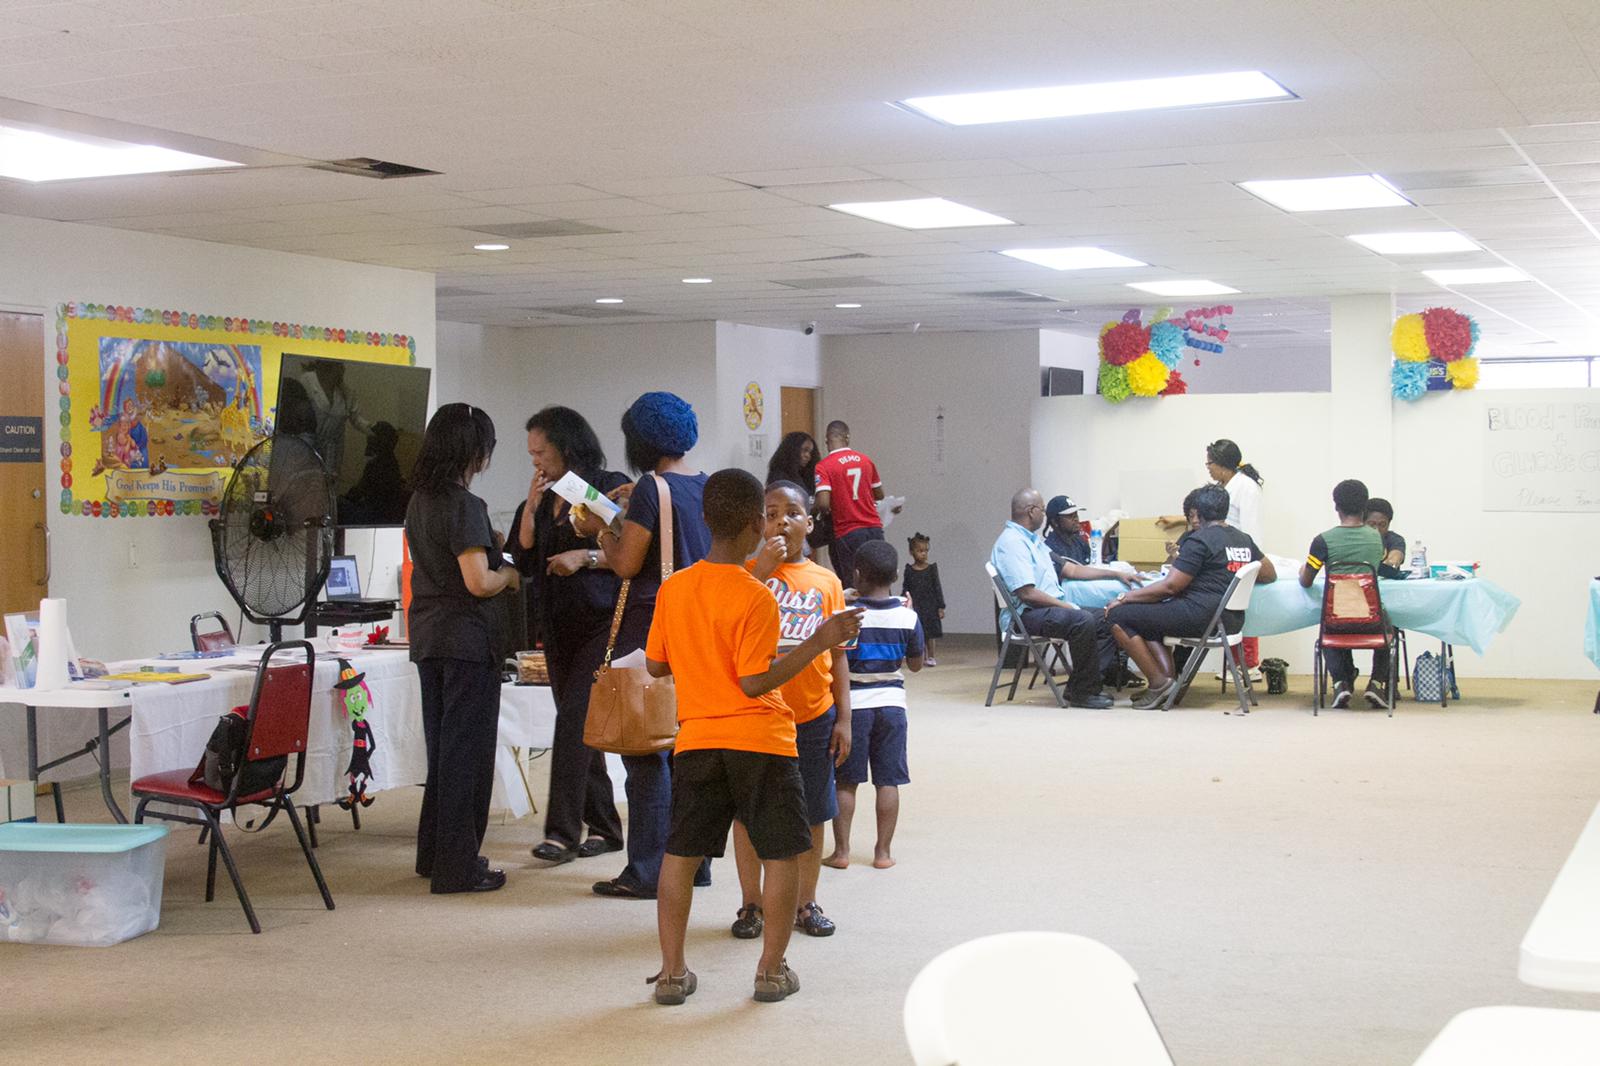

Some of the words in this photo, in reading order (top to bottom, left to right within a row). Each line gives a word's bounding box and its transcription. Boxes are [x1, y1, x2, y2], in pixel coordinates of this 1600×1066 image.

[5, 425, 35, 434] CAUTION
[116, 479, 132, 490] God
[137, 480, 159, 493] Keeps
[162, 479, 176, 490] His
[847, 467, 862, 501] 7
[1225, 546, 1251, 562] NEED
[780, 611, 823, 640] hill
